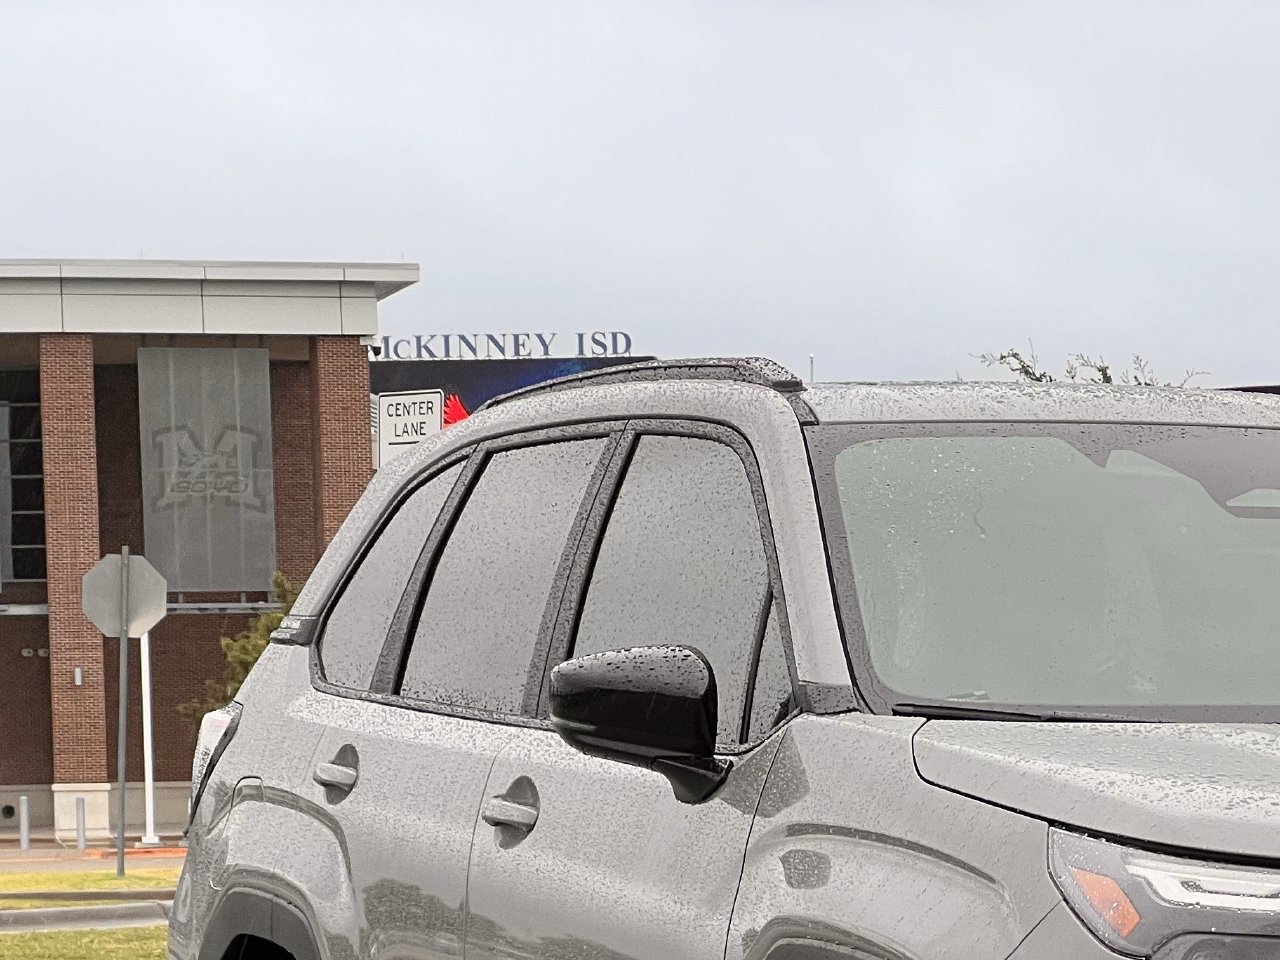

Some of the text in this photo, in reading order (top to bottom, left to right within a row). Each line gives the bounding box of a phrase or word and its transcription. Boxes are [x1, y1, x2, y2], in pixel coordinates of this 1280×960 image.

[575, 331, 632, 357] ISD
[386, 400, 434, 417] CENTER
[394, 421, 427, 437] LANE
